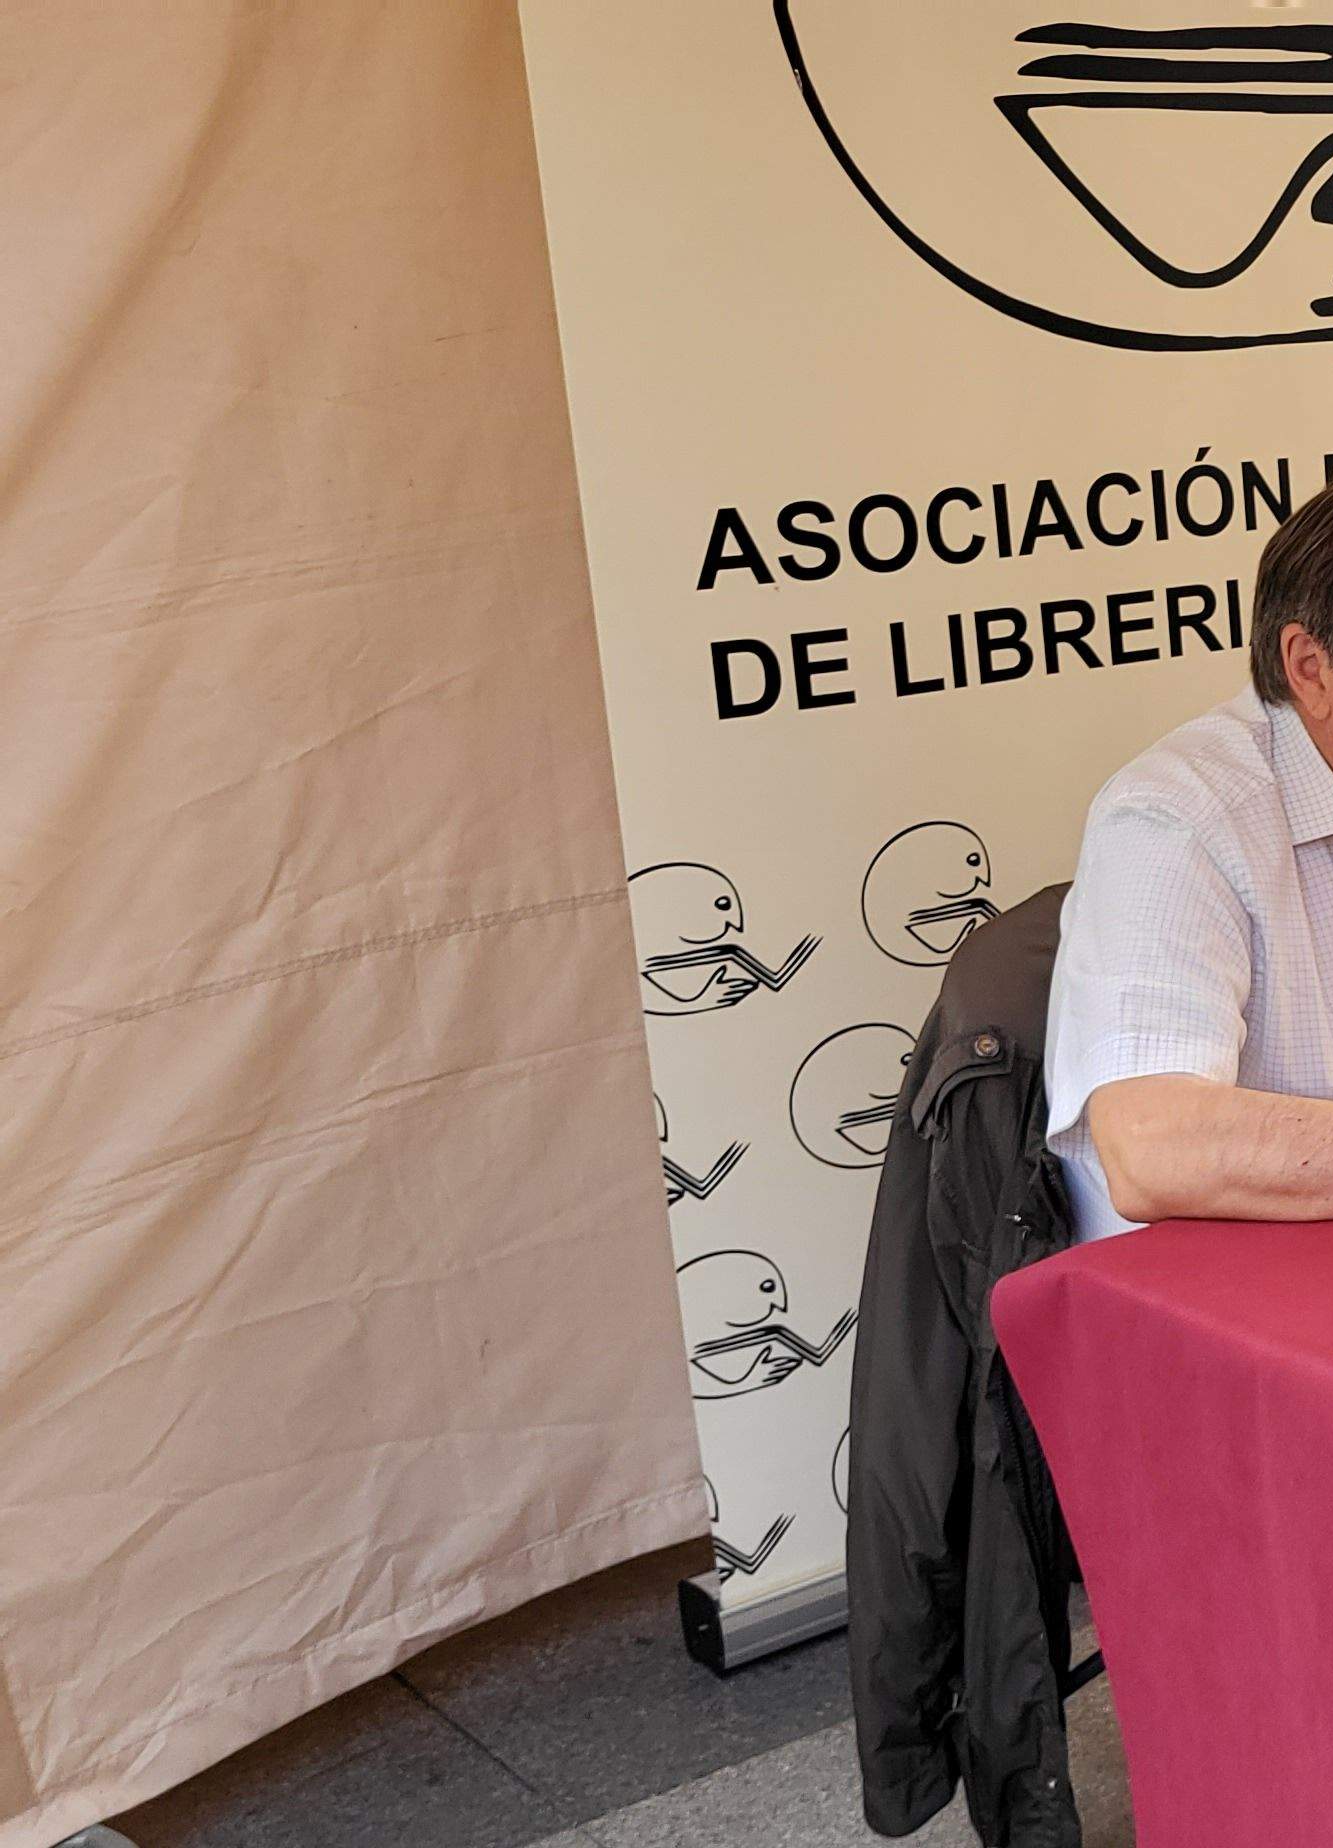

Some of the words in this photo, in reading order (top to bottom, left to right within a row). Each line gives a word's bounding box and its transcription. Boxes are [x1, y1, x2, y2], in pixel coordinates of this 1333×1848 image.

[696, 446, 1293, 591] ASOCIACIÓN
[710, 627, 857, 720] DE
[889, 578, 1253, 698] LIBRERI
